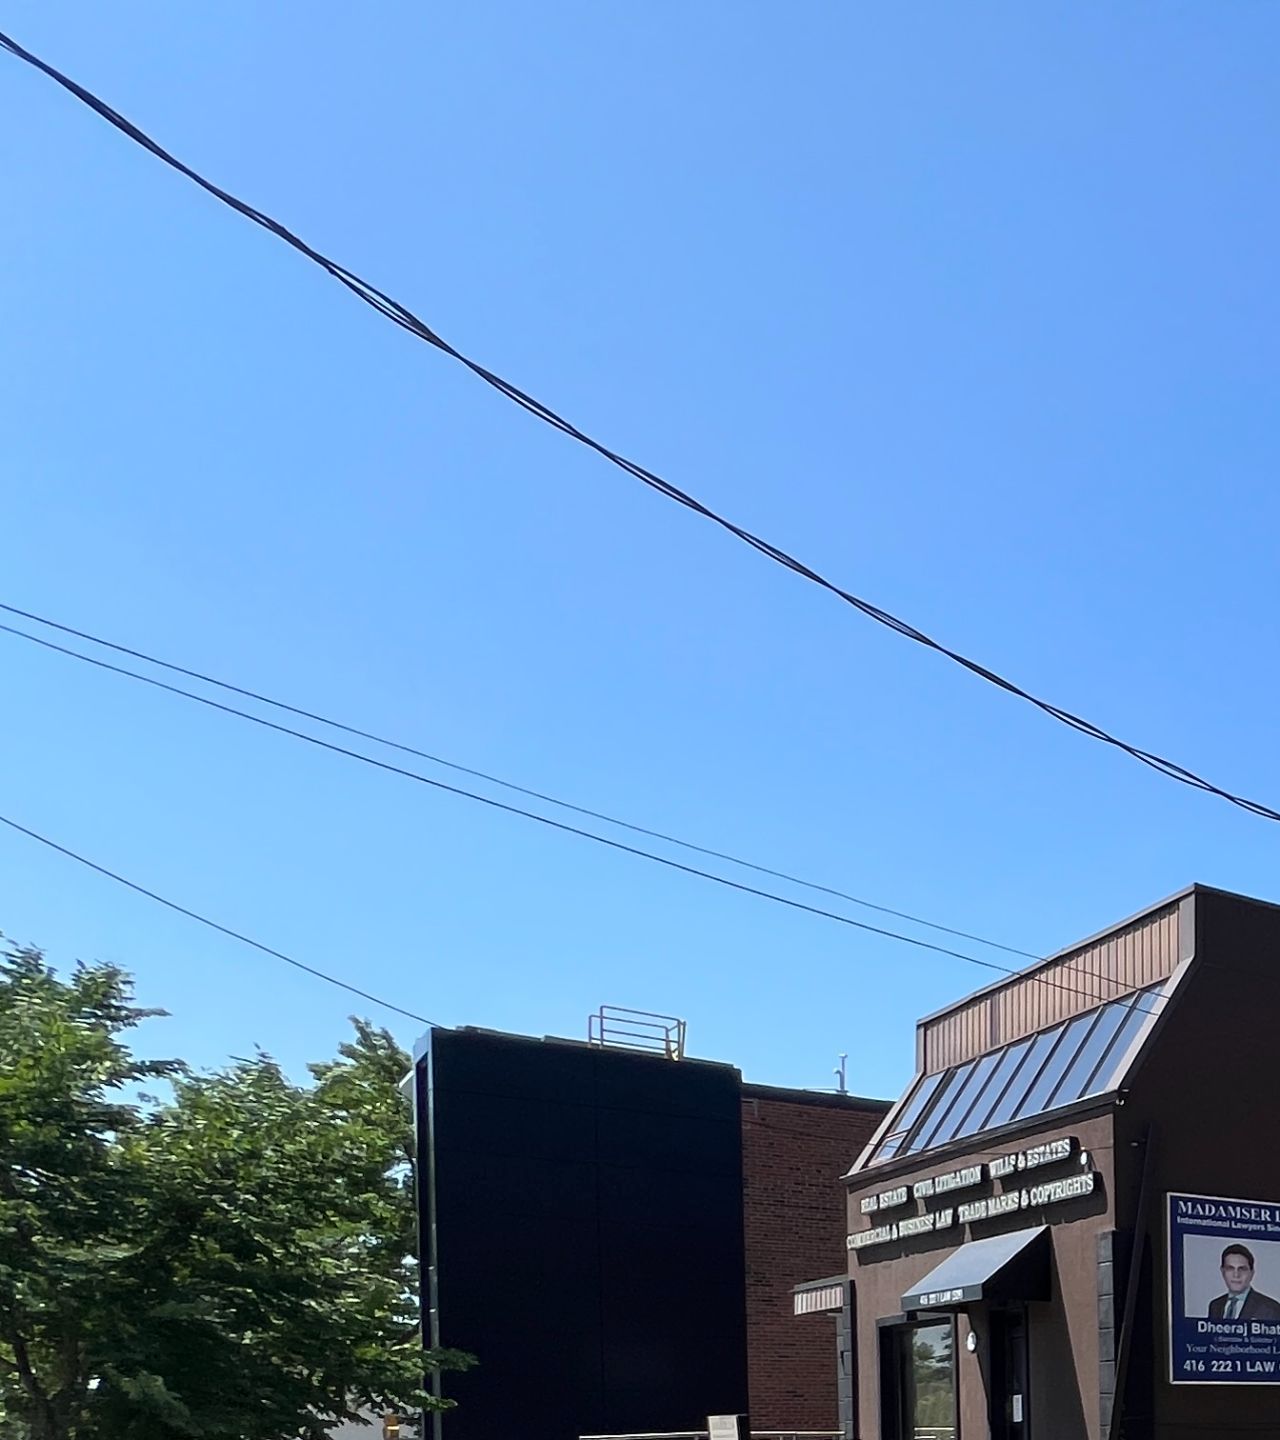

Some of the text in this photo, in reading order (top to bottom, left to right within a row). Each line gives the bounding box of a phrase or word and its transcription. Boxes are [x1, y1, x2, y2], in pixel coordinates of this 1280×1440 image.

[935, 1164, 982, 1195] LITIGATION
[1026, 1138, 1071, 1169] ESTATES
[935, 1208, 954, 1230] LAW
[957, 1200, 988, 1224] TRADE
[987, 1189, 1020, 1215] MARKS
[1020, 1188, 1029, 1209] &
[1030, 1172, 1094, 1207] COPYRIGHTS
[1178, 1200, 1272, 1221] MADAMSER
[1177, 1215, 1230, 1228] International
[1231, 1220, 1266, 1232] Lawyers
[1197, 1320, 1248, 1337] Dheeraj
[1186, 1343, 1208, 1353] Your
[1209, 1344, 1271, 1356] Neighborhood
[1183, 1360, 1206, 1372] 416
[1211, 1360, 1233, 1373] 222
[1246, 1361, 1276, 1373] LAW
